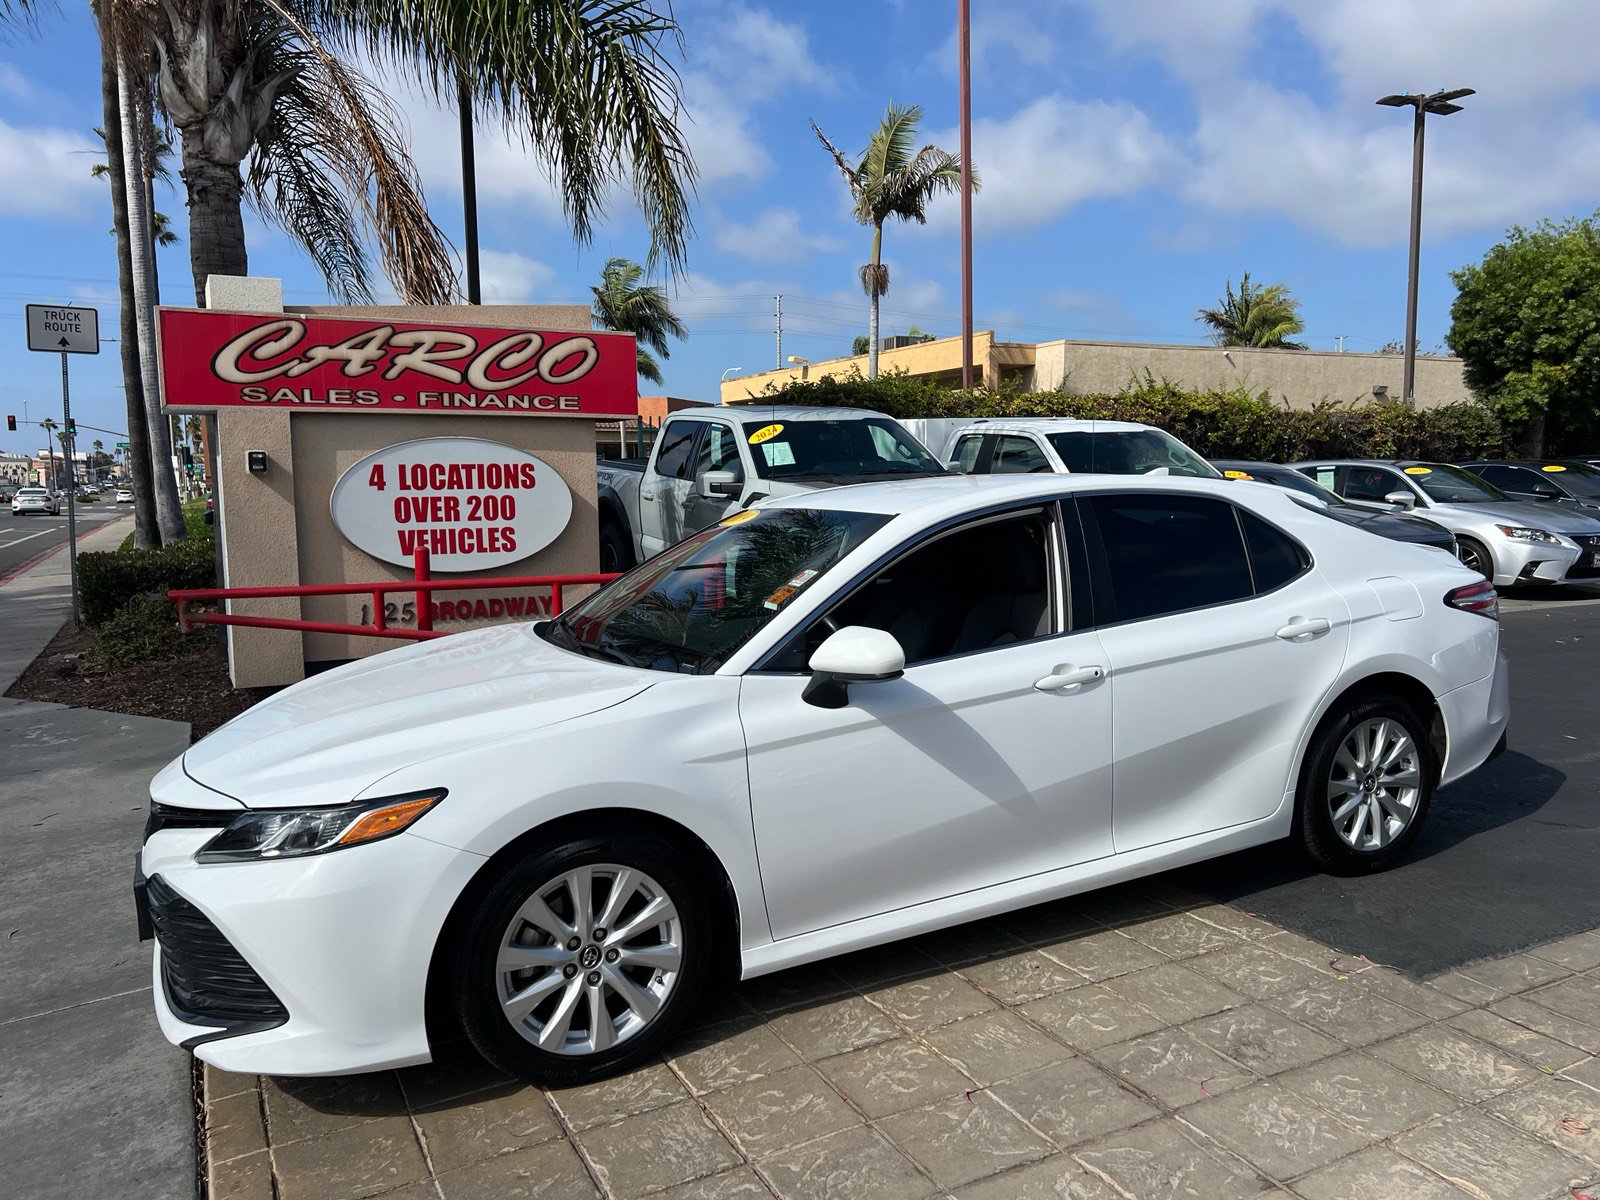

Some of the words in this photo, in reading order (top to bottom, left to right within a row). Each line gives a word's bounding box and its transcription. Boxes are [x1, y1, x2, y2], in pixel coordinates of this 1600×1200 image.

[44, 310, 81, 322] TRUCK
[44, 322, 82, 334] ROUTE
[211, 319, 599, 392] CARCO
[241, 387, 380, 406] SALES
[418, 392, 581, 411] FINANCE
[755, 425, 778, 442] 2024
[368, 464, 386, 491] 4
[398, 463, 536, 491] LOCATIONS
[394, 496, 460, 523] OVER
[467, 495, 516, 521] 200
[398, 528, 516, 555] VEHICLES
